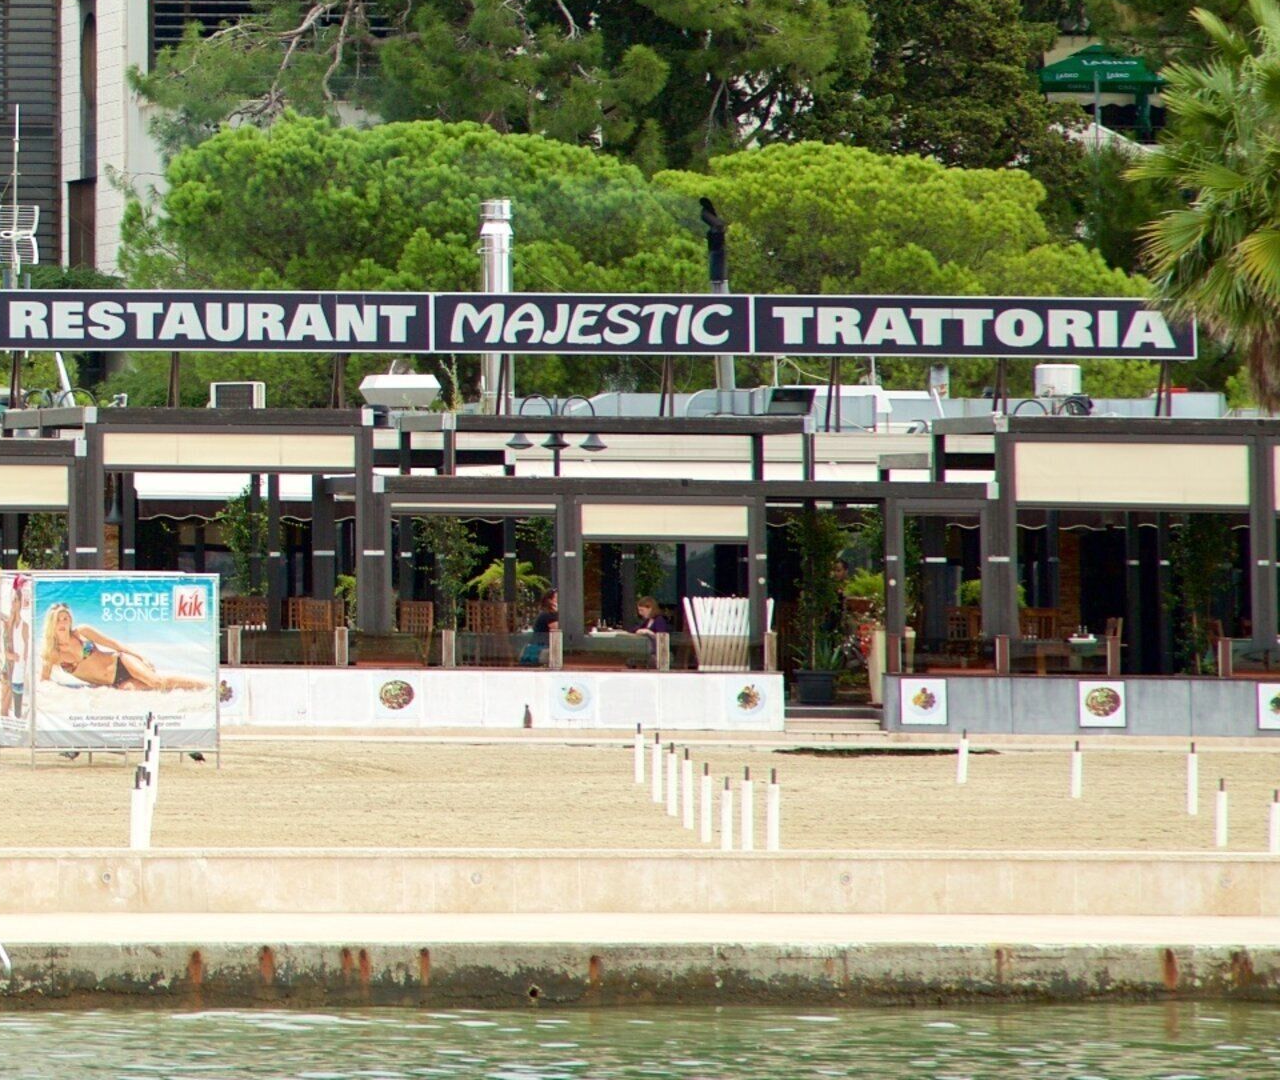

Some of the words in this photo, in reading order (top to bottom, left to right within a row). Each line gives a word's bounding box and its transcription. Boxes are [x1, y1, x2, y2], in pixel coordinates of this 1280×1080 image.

[8, 300, 417, 343] RESTAURANT
[449, 302, 733, 346] MAJESTIC
[771, 305, 1177, 349] TRATTORIA
[101, 592, 169, 607] POLETJE
[178, 588, 204, 617] kik
